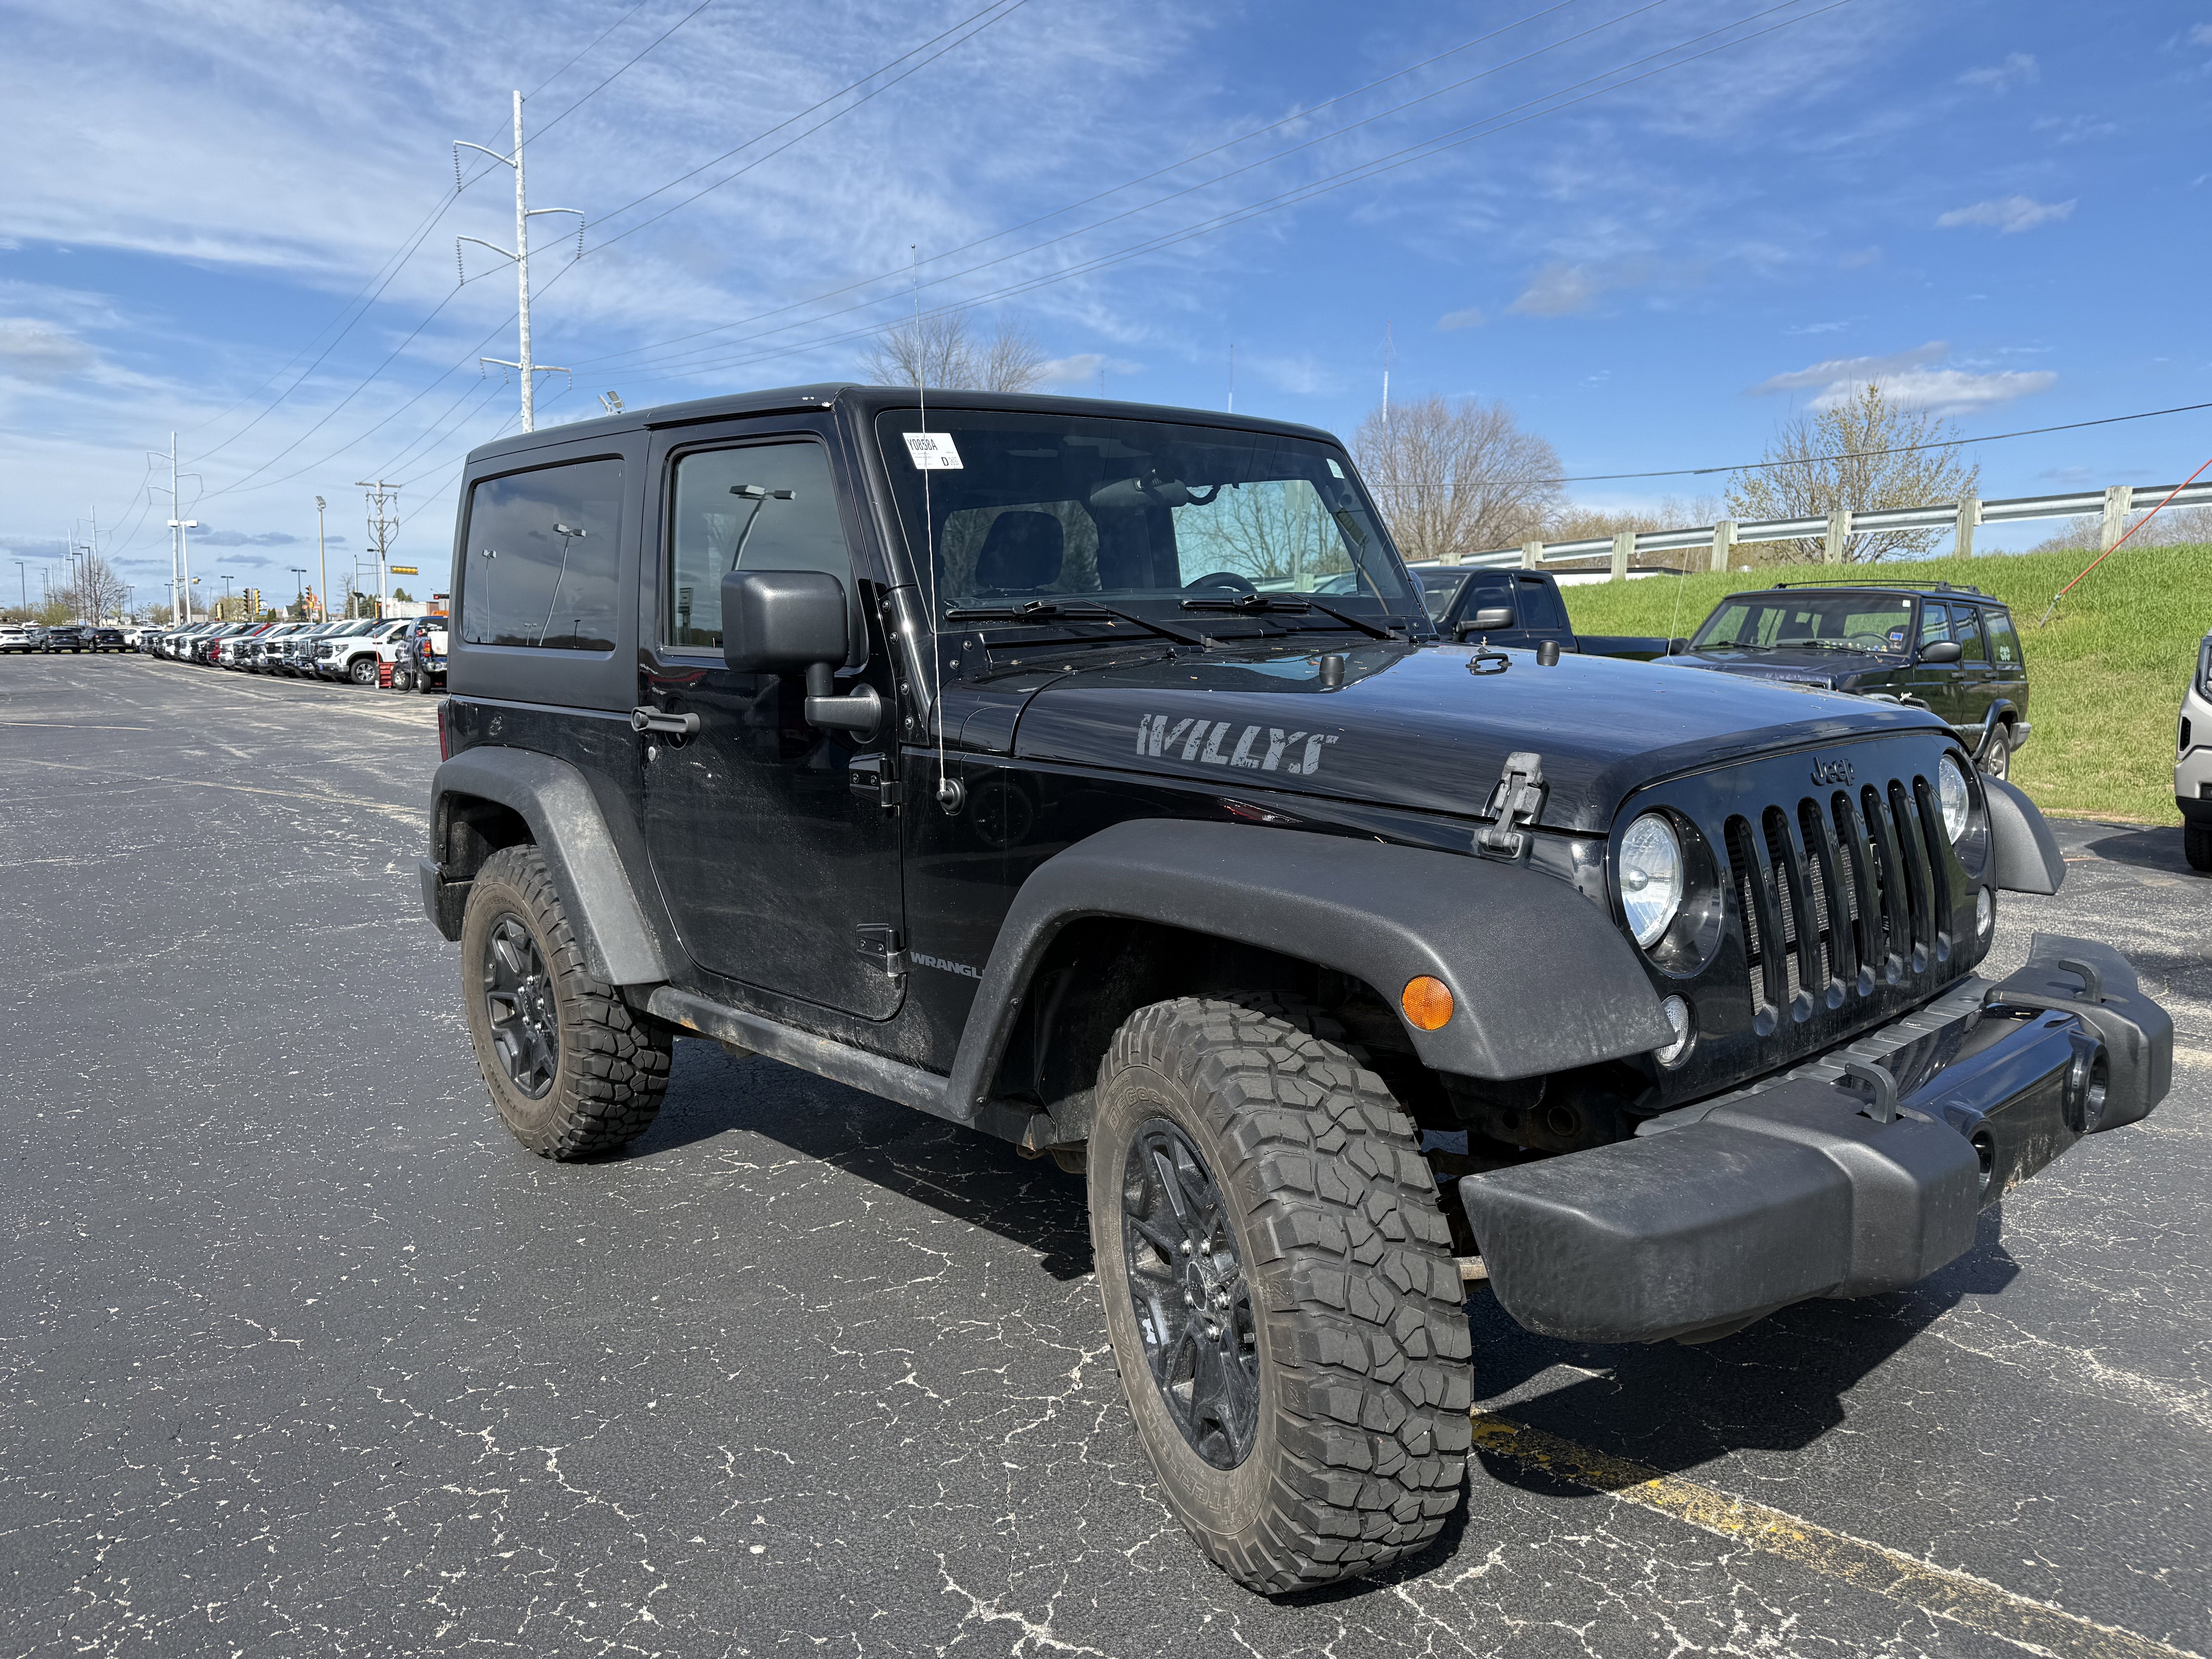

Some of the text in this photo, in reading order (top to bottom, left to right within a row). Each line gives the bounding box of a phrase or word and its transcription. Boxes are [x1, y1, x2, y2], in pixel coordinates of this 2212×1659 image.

[941, 457, 949, 466] D
[1137, 714, 1339, 775] WILLYS
[1810, 757, 1855, 786] Jeep
[910, 951, 985, 979] WRANGL
